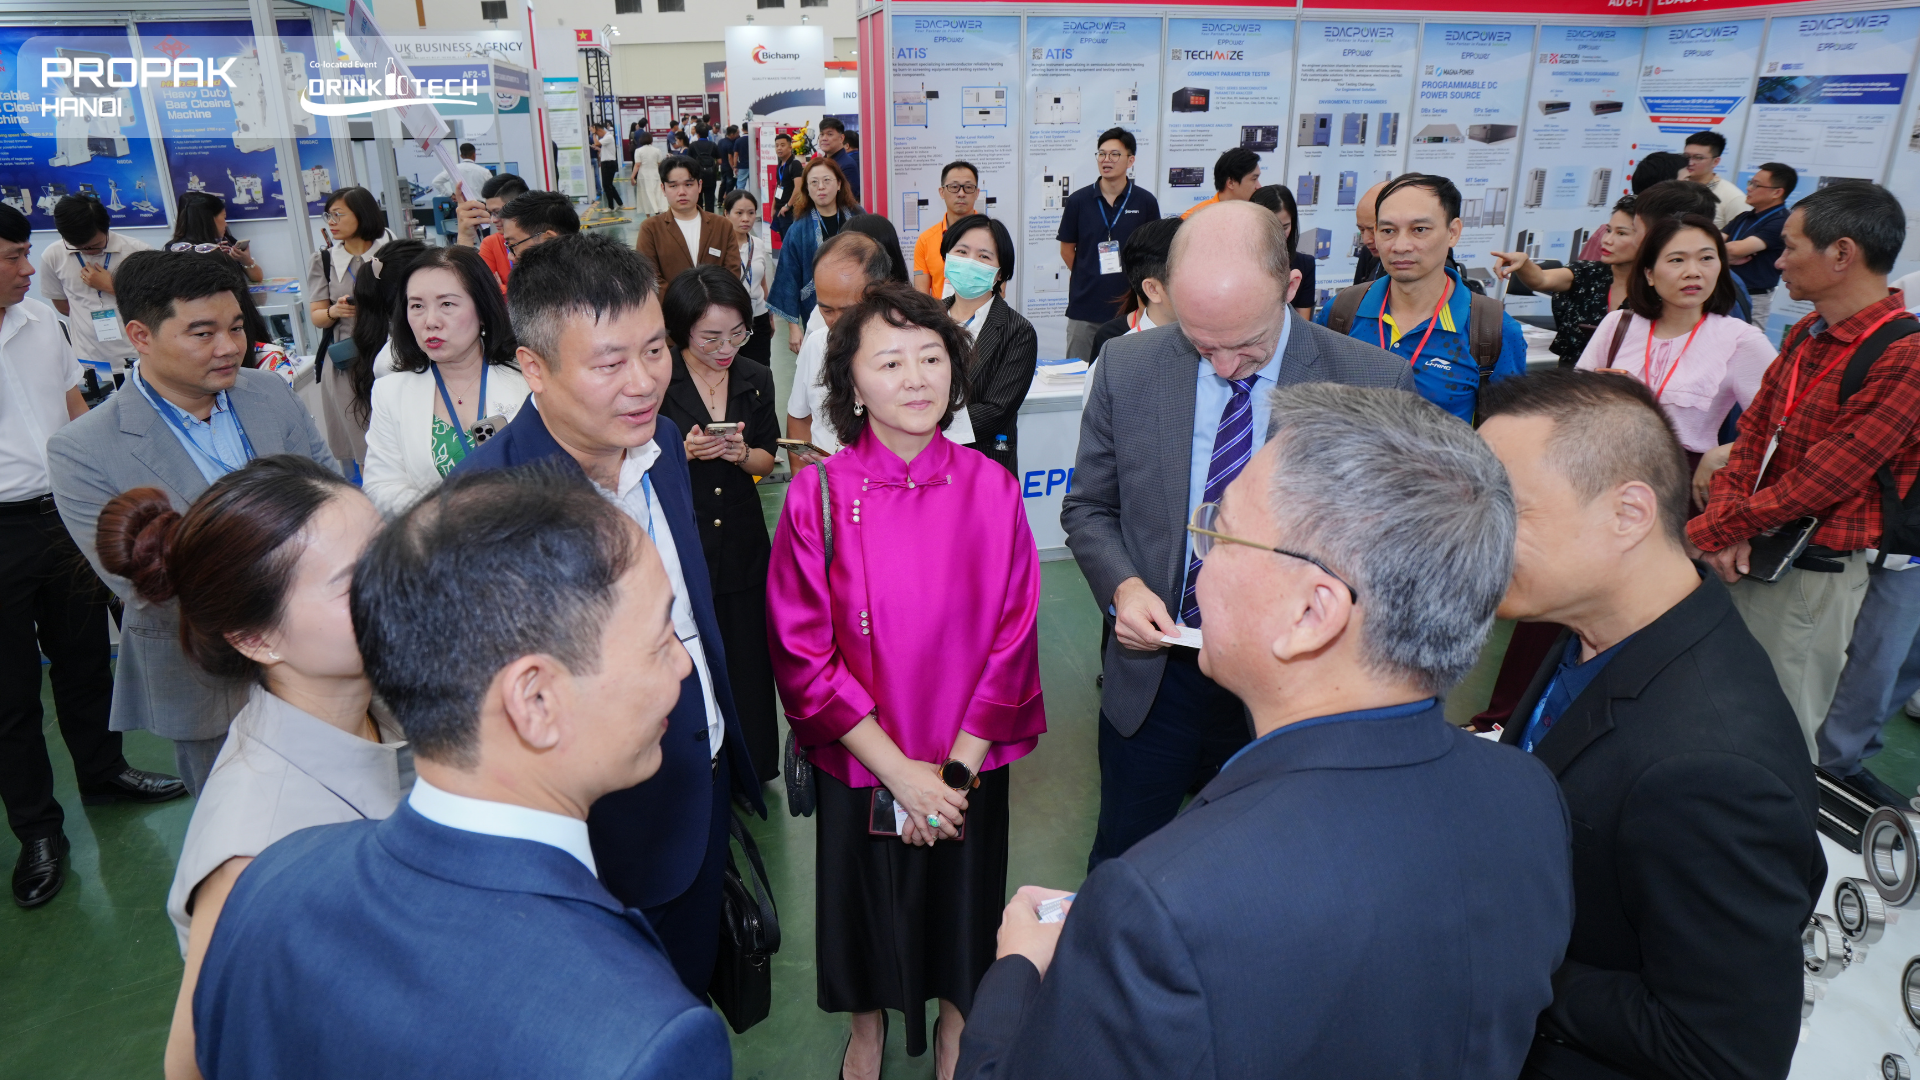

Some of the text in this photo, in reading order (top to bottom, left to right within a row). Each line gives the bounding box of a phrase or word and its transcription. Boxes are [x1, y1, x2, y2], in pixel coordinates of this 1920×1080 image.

[915, 20, 982, 29] EDACPOWER
[1063, 21, 1126, 30] EDACPOWER
[1799, 14, 1890, 32] EDACPOWER
[1202, 24, 1262, 32] EDACPOWER
[1324, 26, 1394, 38] EDACPOWER
[1668, 25, 1739, 40] EDACPOWER
[1445, 30, 1512, 42] EDACPOWER
[1566, 30, 1616, 39] EDACPOWER
[395, 42, 523, 53] UK BUSINESS AGENCY
[762, 52, 800, 60] Bichamp
[897, 48, 927, 59] ATiS
[1045, 48, 1073, 60] ATiS
[1342, 49, 1373, 57] EPPower
[1461, 52, 1490, 60] EPPower
[463, 70, 487, 79] AF2-5
[1422, 81, 1498, 89] PROGRAMMABLE DC
[163, 88, 227, 99] Heavy Duty
[1421, 91, 1481, 99] POWER SOURCE
[165, 99, 231, 109] Bag Closing
[167, 110, 212, 120] Machine
